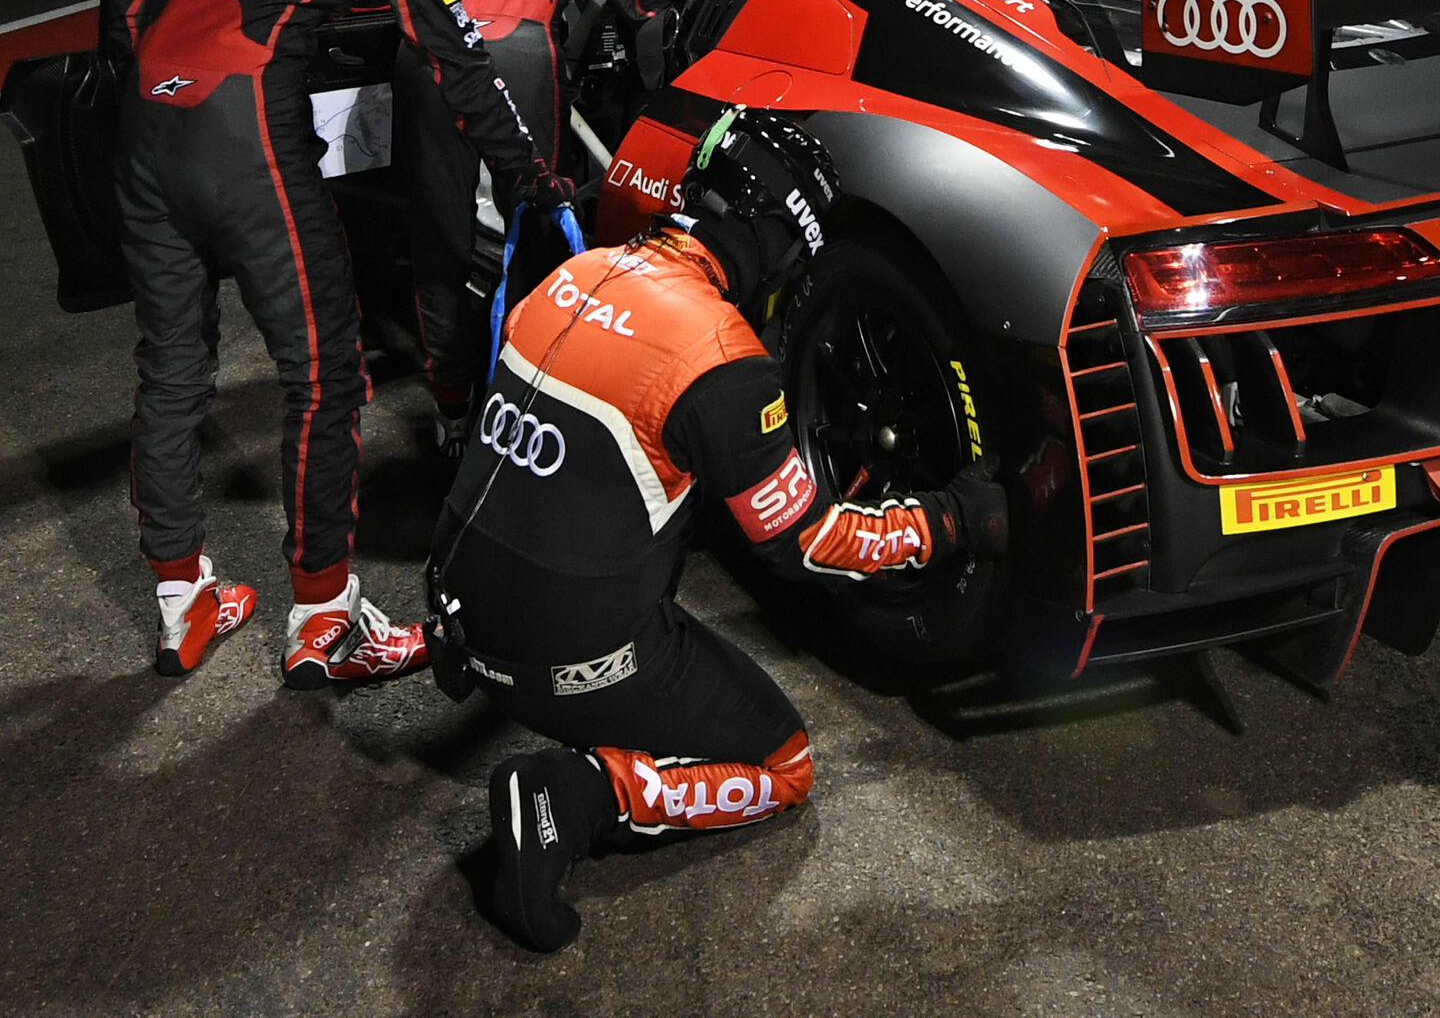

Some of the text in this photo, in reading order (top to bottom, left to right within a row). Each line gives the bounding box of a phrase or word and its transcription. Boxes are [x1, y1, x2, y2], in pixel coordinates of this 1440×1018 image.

[629, 168, 670, 202] Audi
[814, 168, 834, 203] uvex
[785, 188, 825, 257] uvex
[547, 267, 635, 337] TOTAL
[950, 360, 983, 462] PIREL
[750, 456, 808, 521] SR
[1235, 469, 1382, 524] PIRELLI
[634, 759, 779, 819] TOTAL
